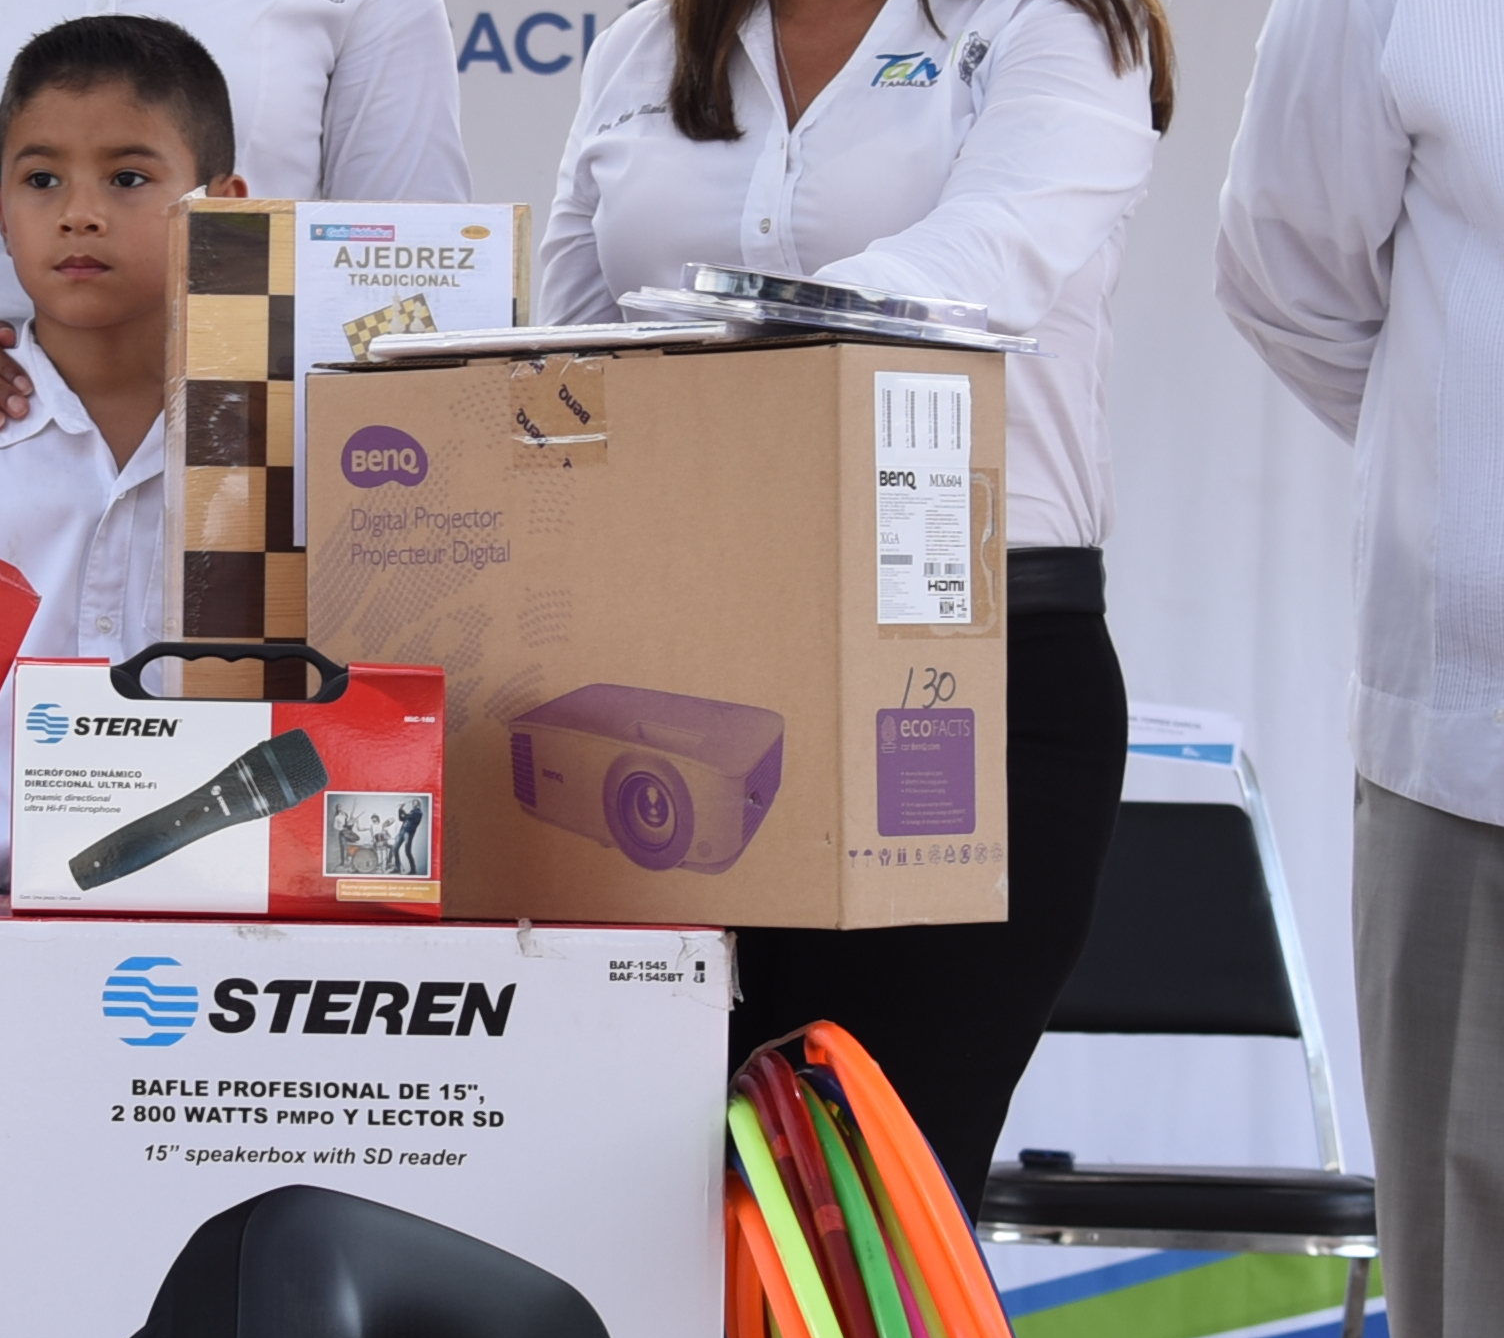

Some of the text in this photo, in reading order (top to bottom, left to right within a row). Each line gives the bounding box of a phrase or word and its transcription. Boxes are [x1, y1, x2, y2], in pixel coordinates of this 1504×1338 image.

[333, 245, 476, 270] AJEDREZ
[348, 273, 461, 288] TRADICIONAL
[557, 383, 592, 425] BenQ
[350, 447, 420, 475] BenQ
[879, 470, 963, 490] BenQ MX604
[351, 506, 503, 537] Digital Projector
[880, 531, 901, 545] XGA
[351, 540, 511, 571] Projecteur Digital
[900, 667, 957, 710] 130
[73, 716, 179, 738] STEREN
[900, 718, 971, 738] ecoFACTS
[24, 767, 143, 779] MICRÓFONO DINÁMICO
[24, 779, 158, 790] DIRECCIONAL ULTRA Hi-Fi
[24, 793, 112, 803] Dynamic directional
[24, 804, 44, 812] ultra
[68, 805, 122, 815] microphone
[609, 960, 668, 971] BAF-1545
[609, 972, 685, 982] BAF-1545BT
[208, 977, 518, 1038] STEREN
[132, 1079, 486, 1105] BAFLE PROFESIONAL DE 15",
[111, 1105, 505, 1128] 2 800 WATTS PMPO Y LECTOR SD
[184, 1144, 309, 1169] speakerbox
[312, 1145, 358, 1165] with
[362, 1146, 393, 1165] SD
[398, 1147, 467, 1167] reader
